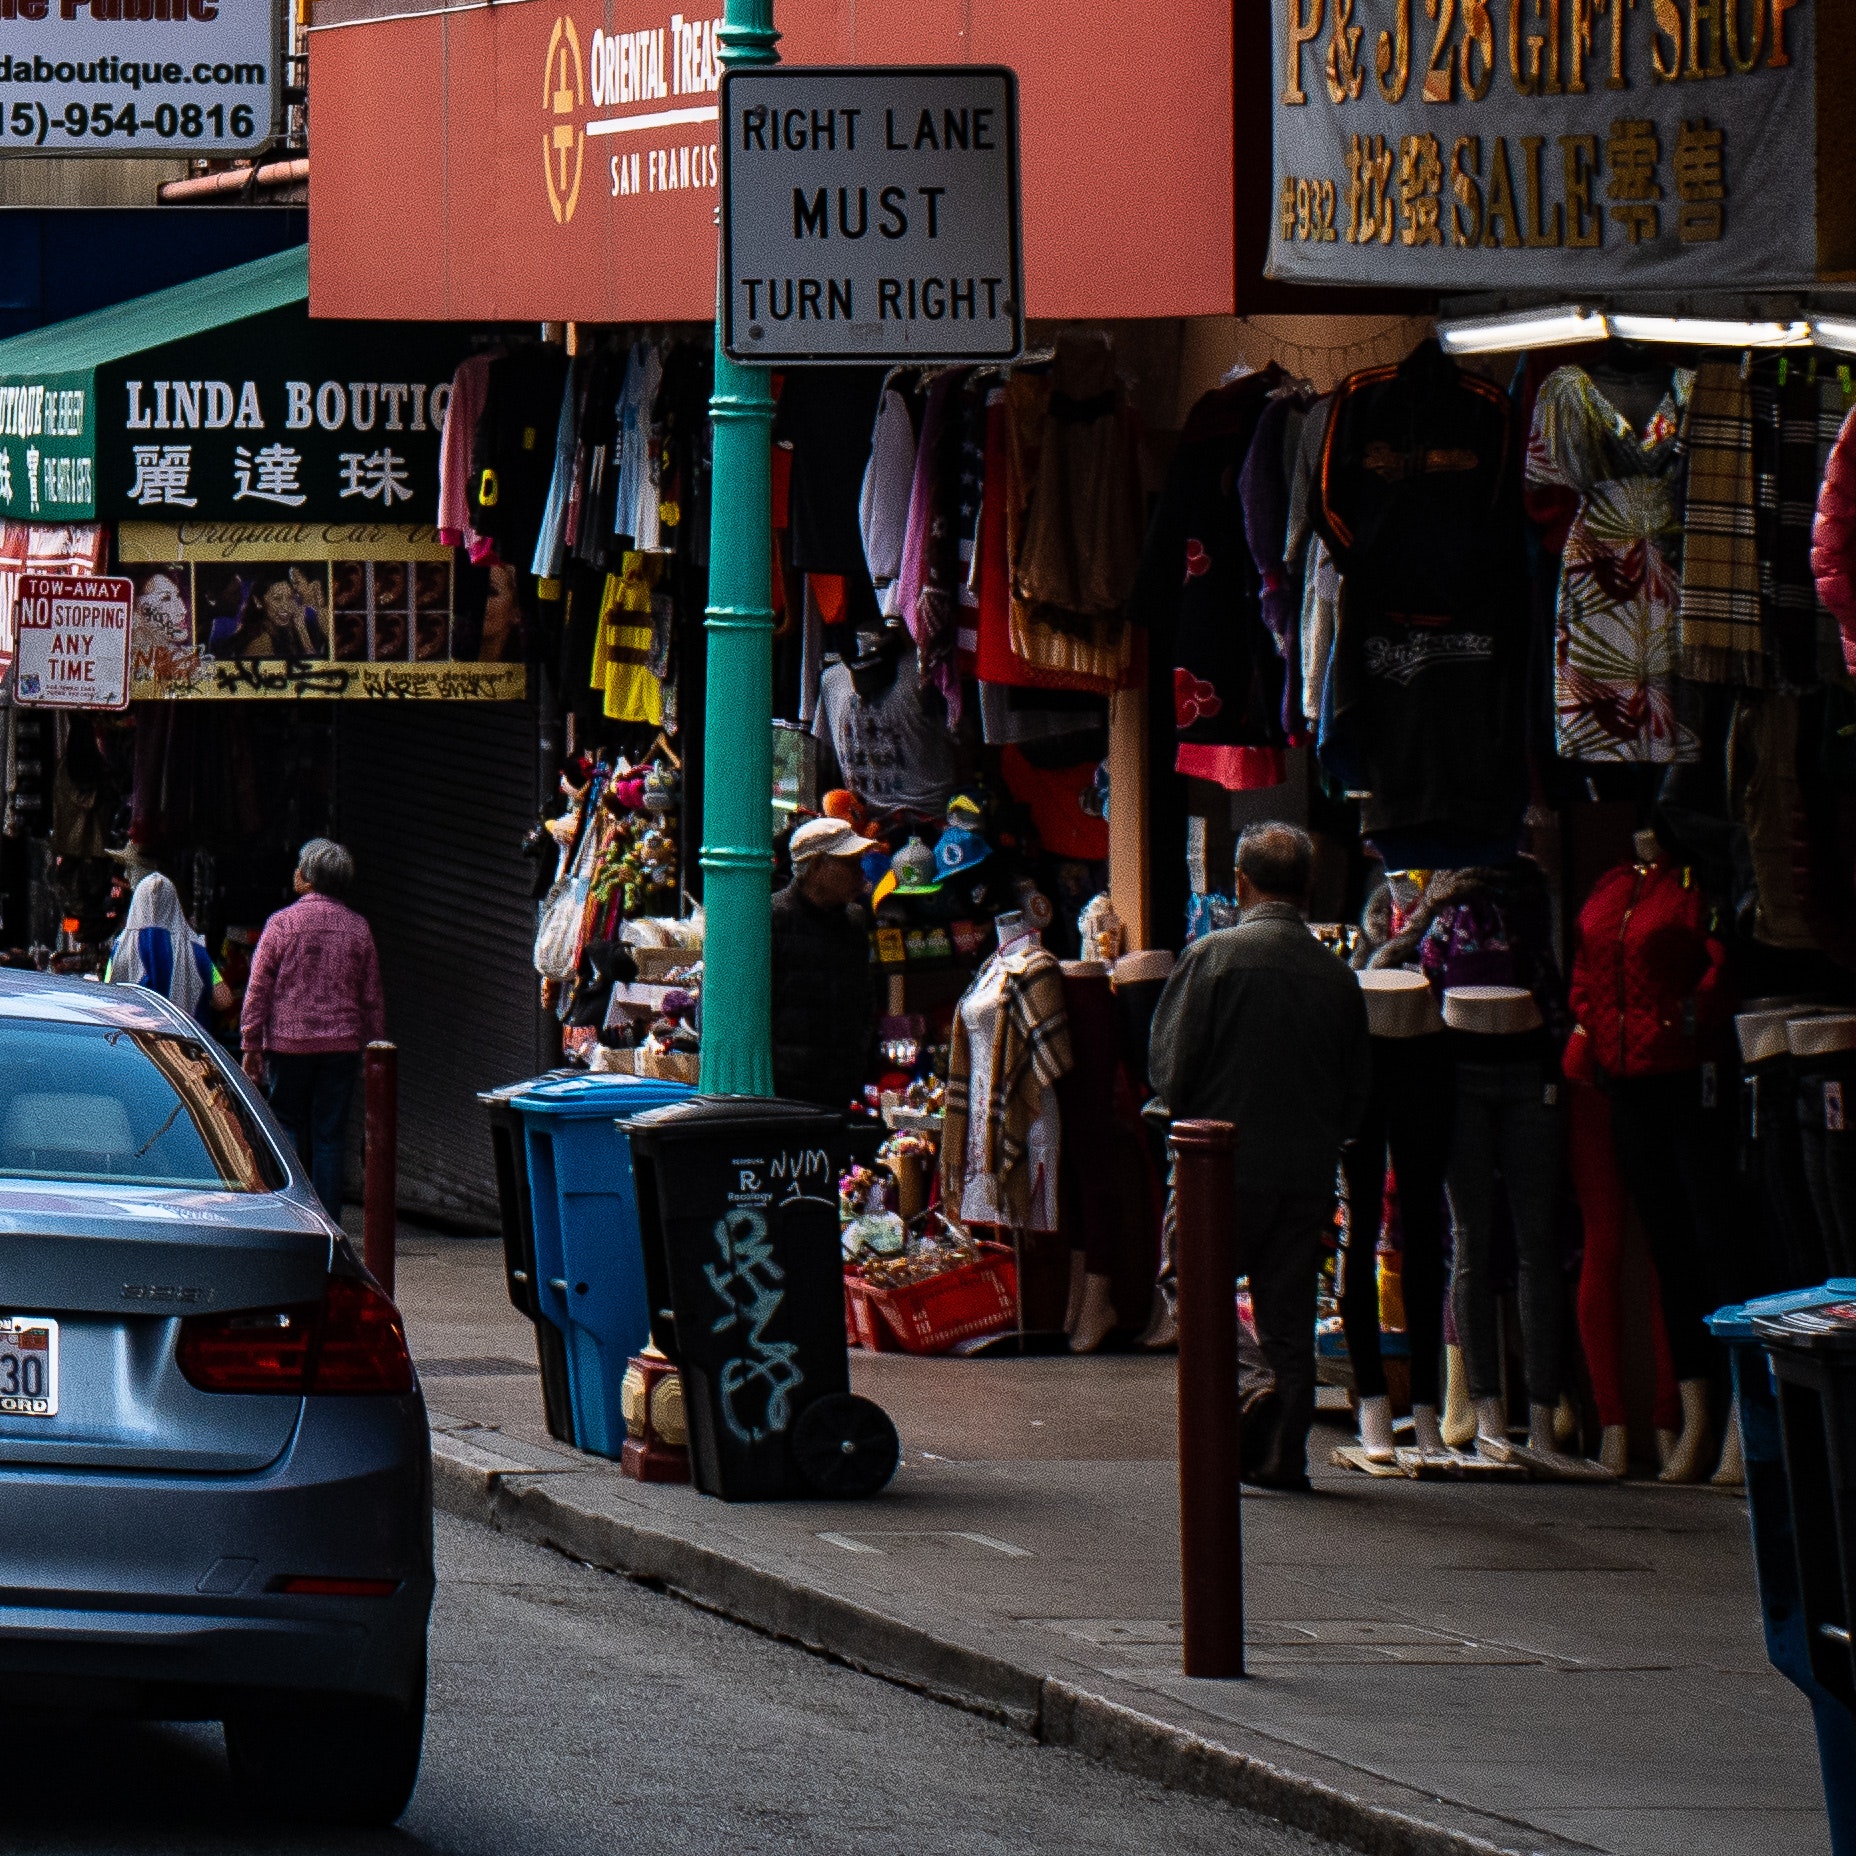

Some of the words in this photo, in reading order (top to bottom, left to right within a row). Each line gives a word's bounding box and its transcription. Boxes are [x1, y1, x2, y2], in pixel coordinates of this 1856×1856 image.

[592, 30, 666, 104] ORIENTAL
[744, 109, 860, 150] RIGHT
[887, 108, 994, 150] LANE
[612, 155, 639, 194] SAN
[649, 144, 718, 192] FRANCIS
[1450, 135, 1602, 247] SALE
[794, 187, 944, 238] MUST
[742, 279, 852, 320] TURN
[879, 279, 1003, 319] RIGHT
[127, 382, 262, 428] LINDA
[127, 444, 414, 507] 麗達珠
[29, 580, 121, 597] TOW-AWAY
[21, 597, 49, 625] NO
[55, 605, 124, 629] STOPPING
[53, 635, 92, 654] ANY
[50, 660, 94, 681] TIME
